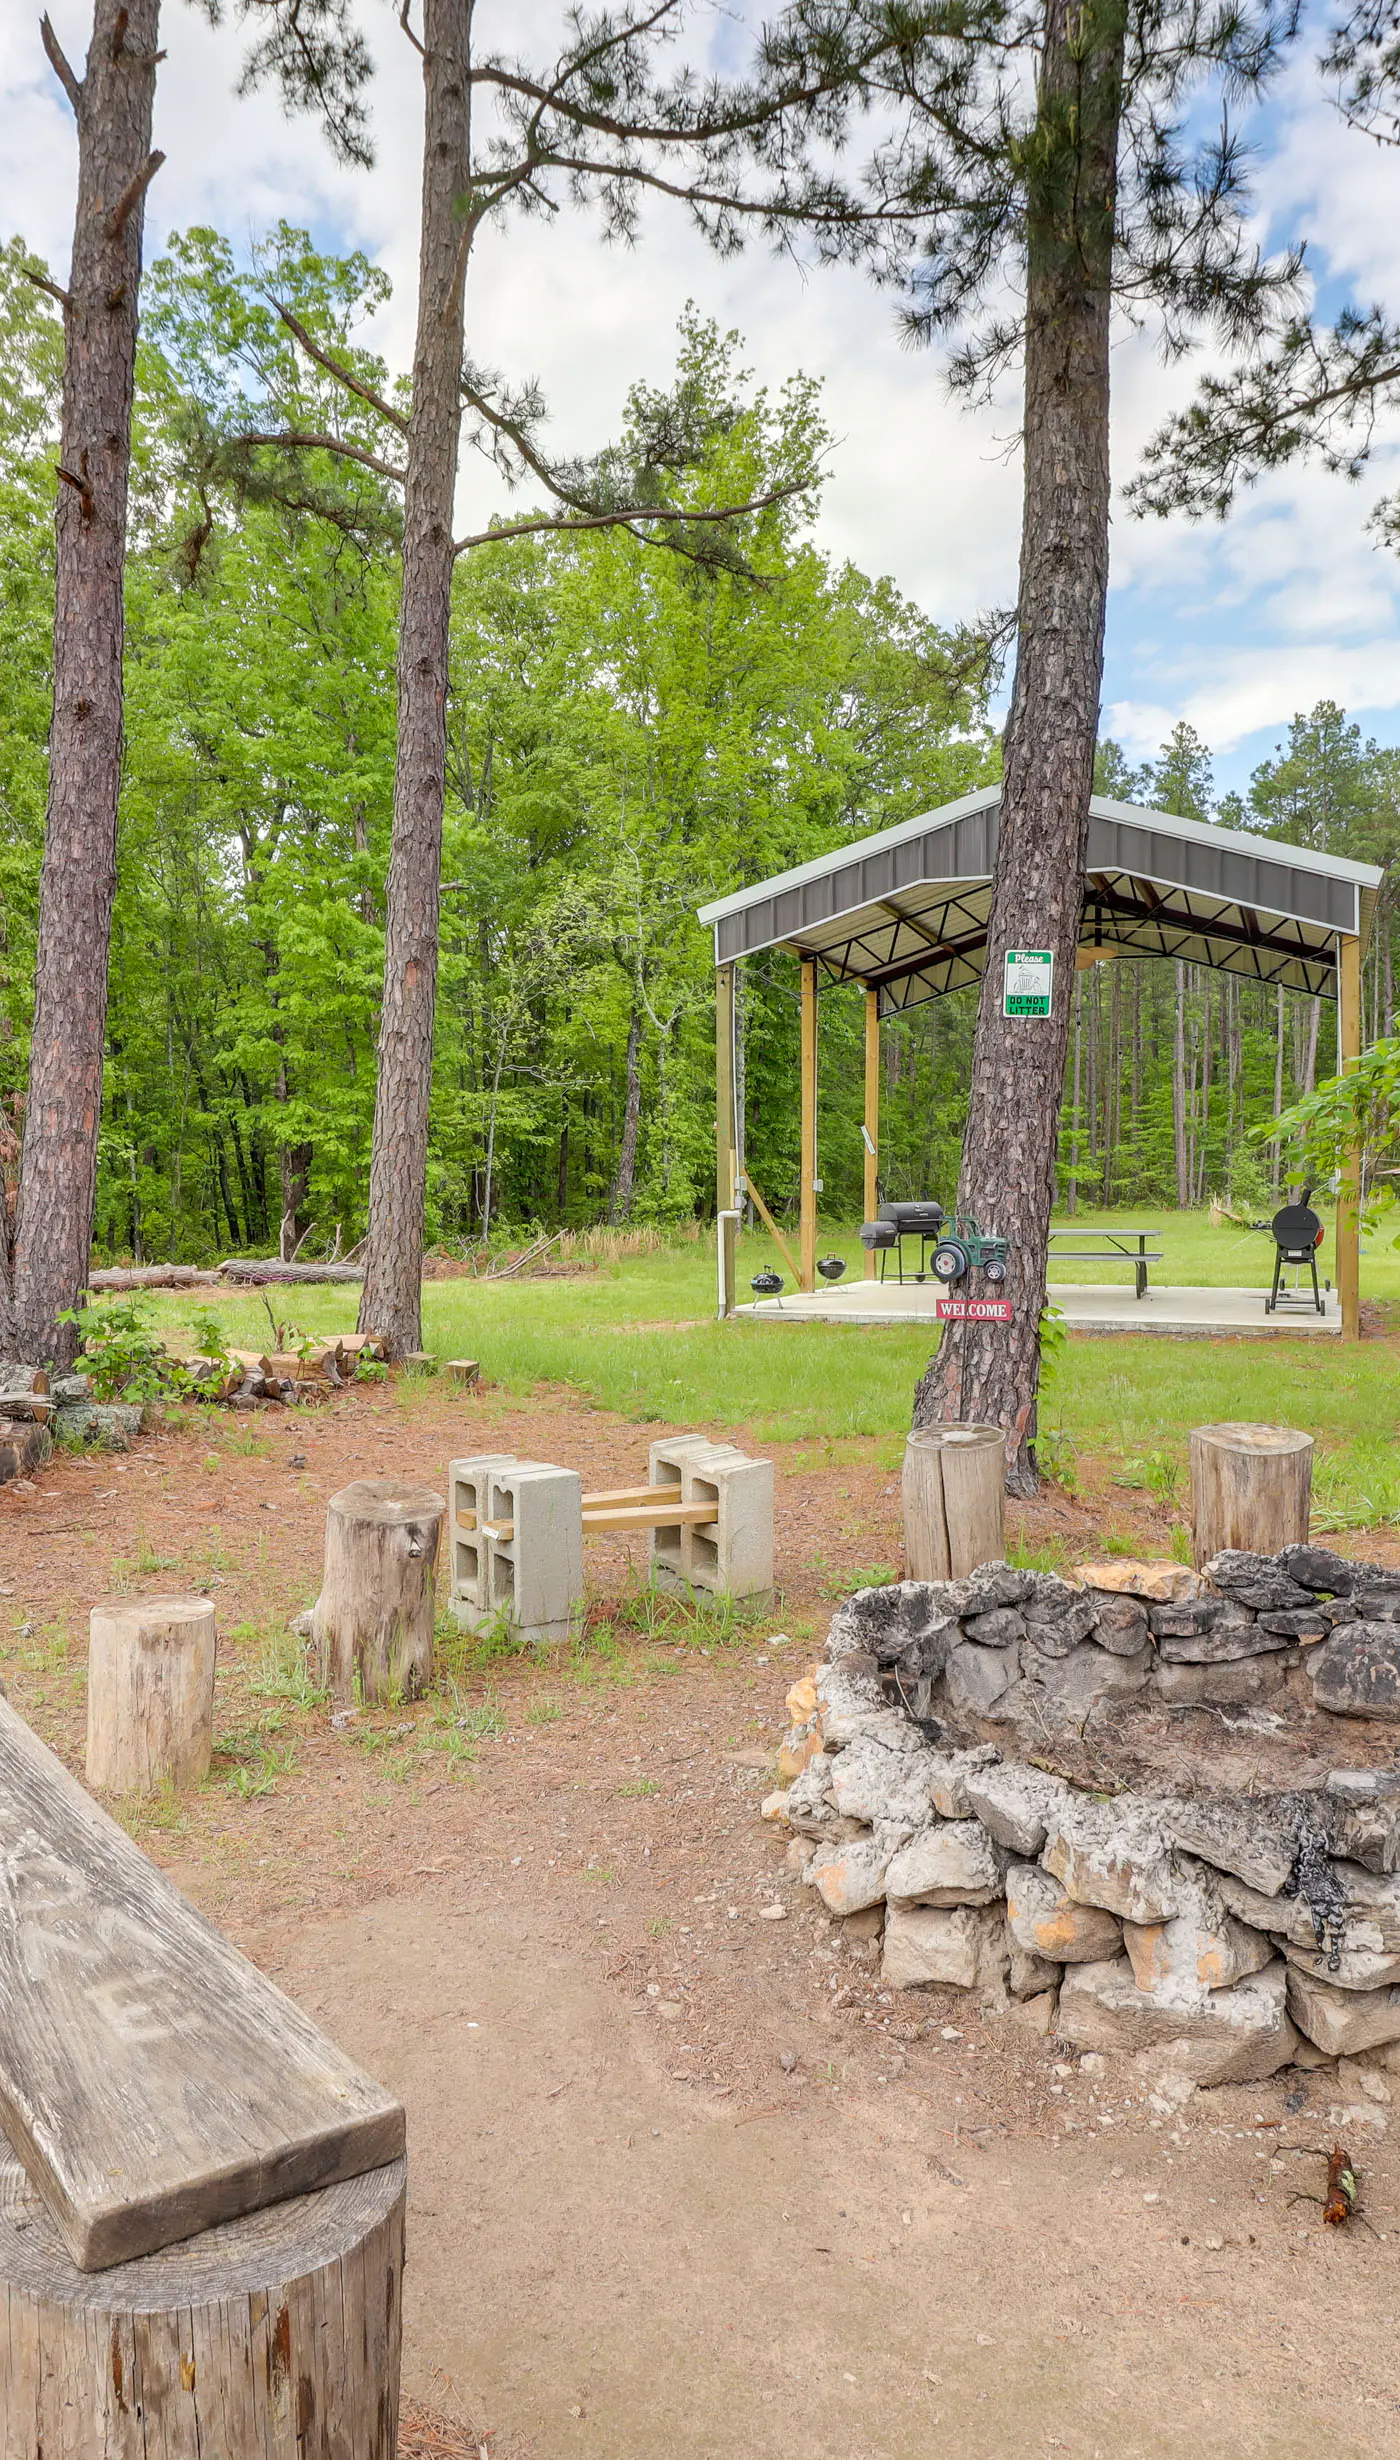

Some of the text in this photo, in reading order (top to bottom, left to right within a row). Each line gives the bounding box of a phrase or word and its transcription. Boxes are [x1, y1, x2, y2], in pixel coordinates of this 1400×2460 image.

[1015, 953, 1044, 963] Please
[1026, 997, 1046, 1005] NOT
[1009, 1006, 1045, 1015] LITTER
[940, 1303, 1007, 1317] WELCOME
